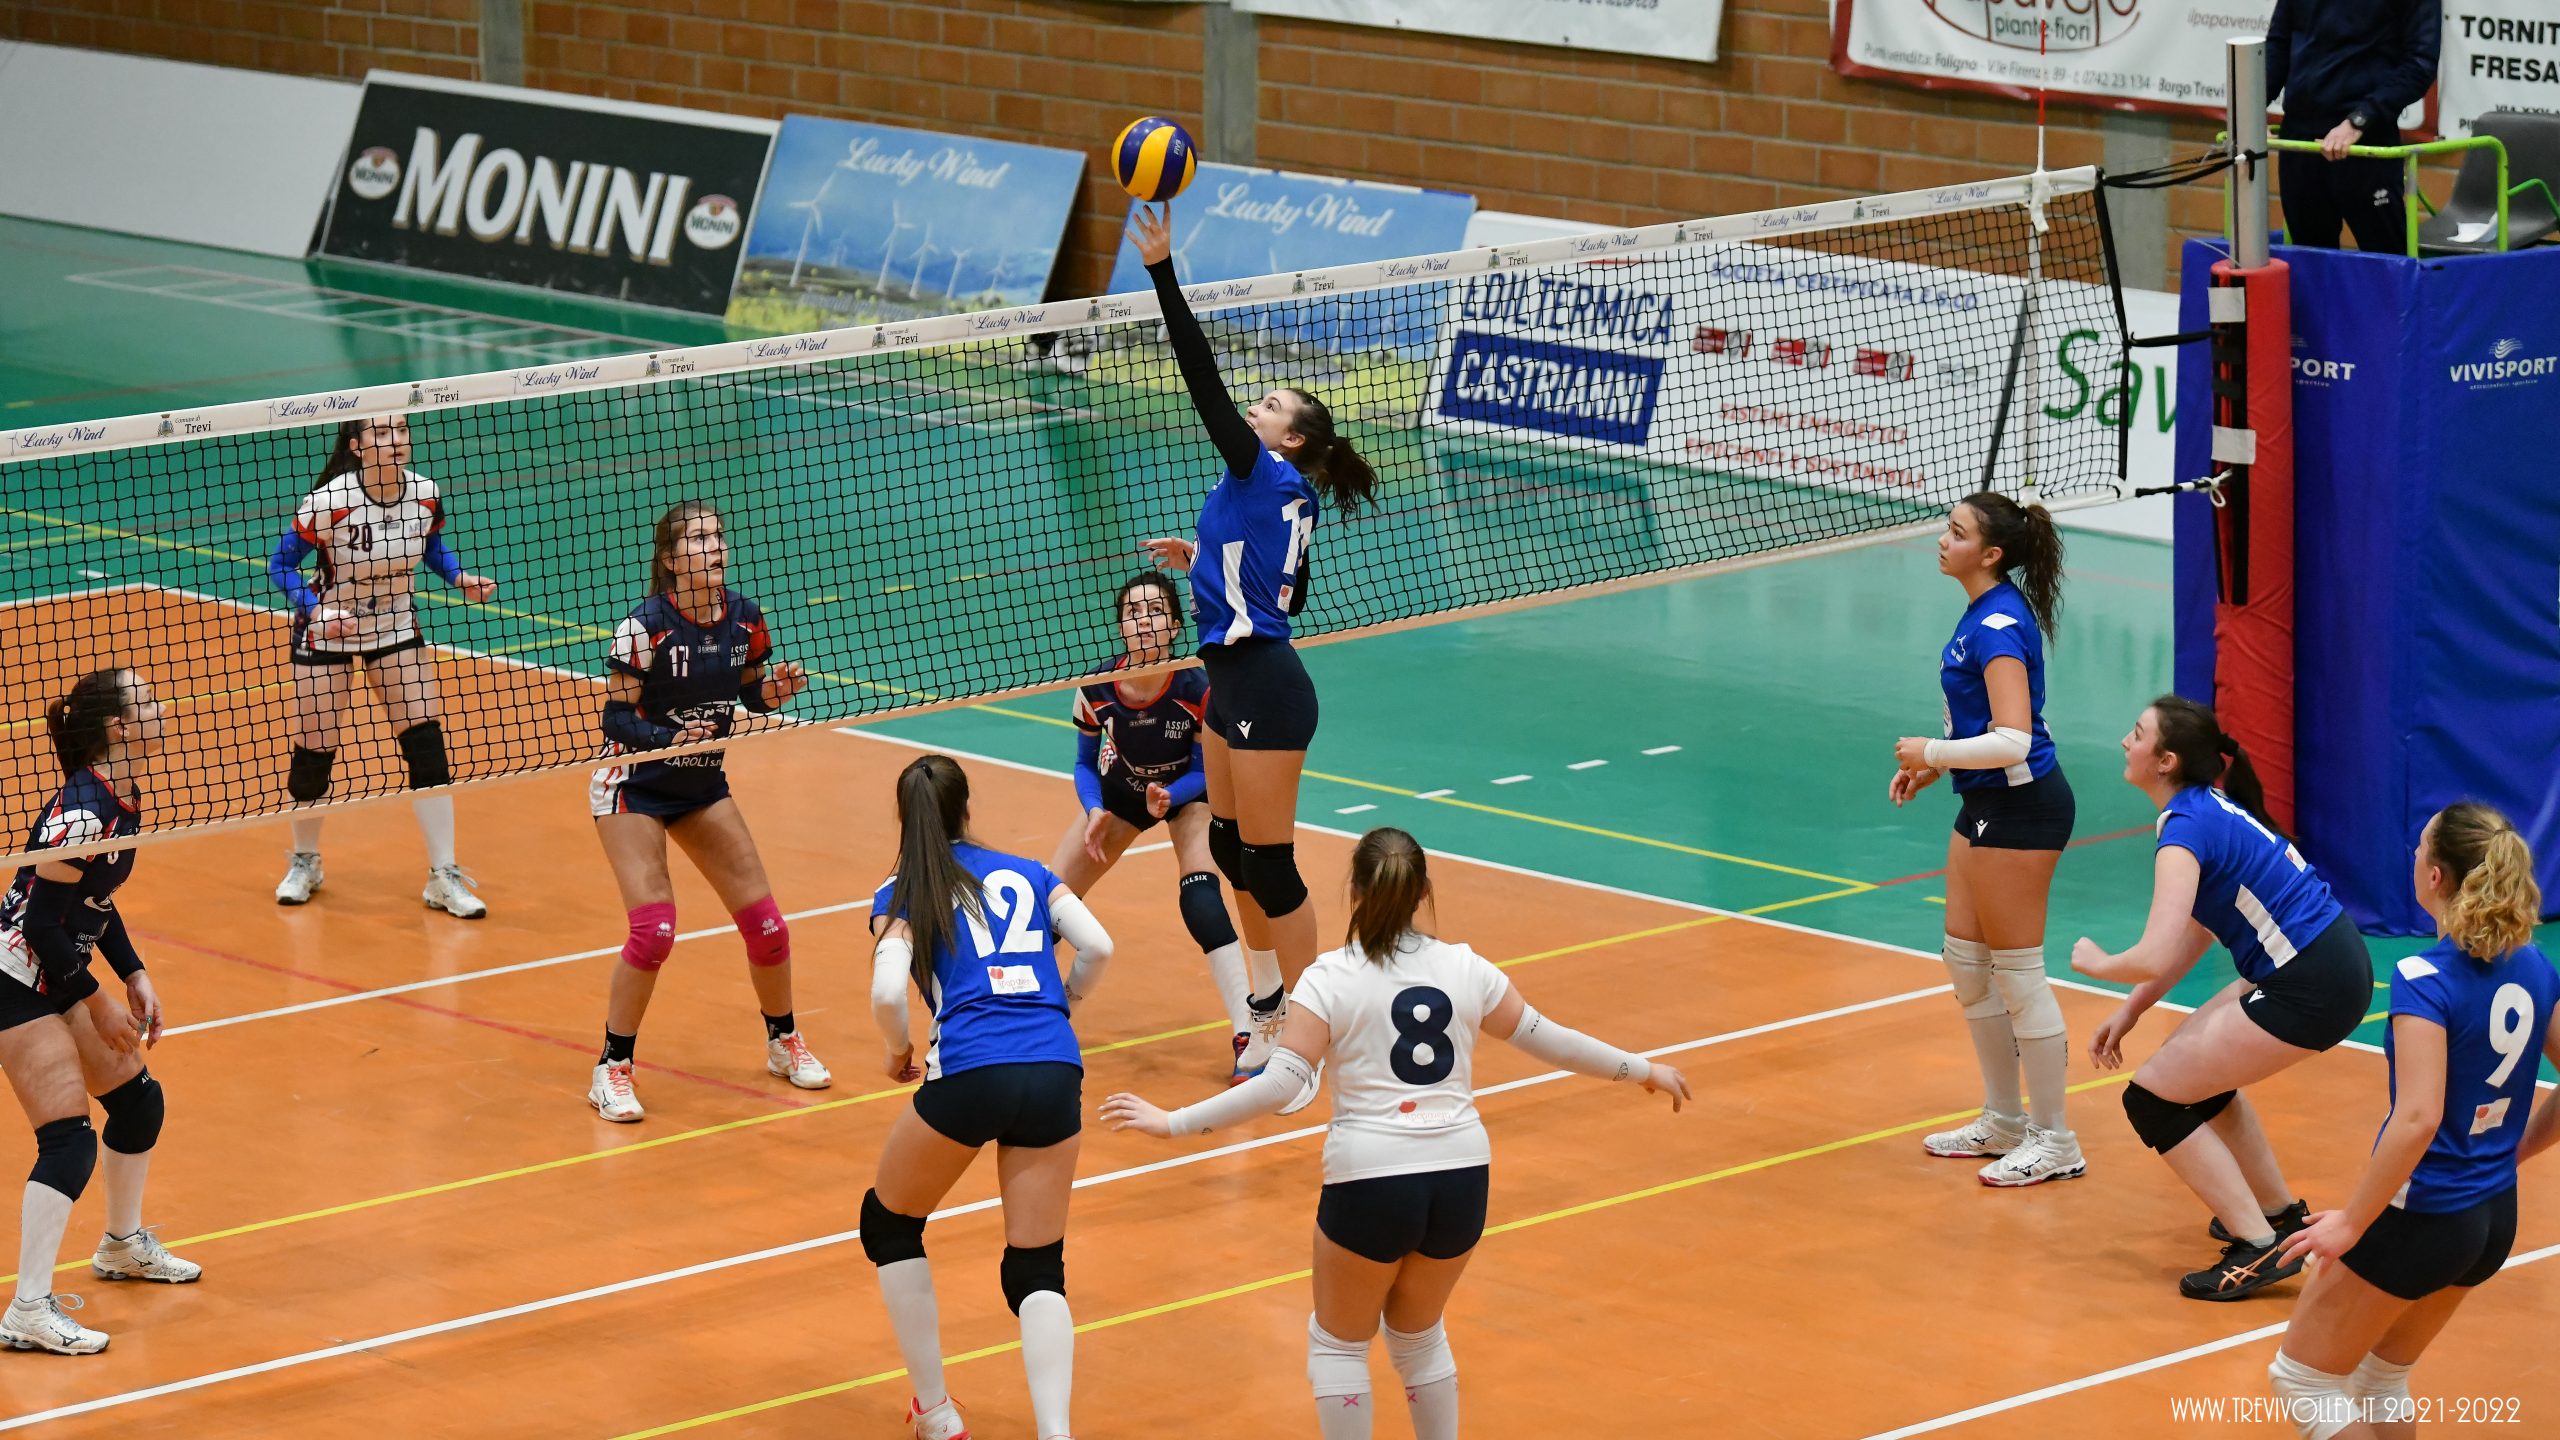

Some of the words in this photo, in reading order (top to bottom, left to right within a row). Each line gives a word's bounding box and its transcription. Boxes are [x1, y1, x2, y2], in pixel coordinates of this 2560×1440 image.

[1935, 51, 1977, 72] Foligno
[2111, 74, 2126, 87] 23
[2130, 75, 2150, 89] 134
[2158, 77, 2192, 97] Borgo
[2194, 81, 2226, 97] Trevi
[838, 134, 924, 188] Lucky
[927, 148, 1012, 191] Wind
[392, 126, 693, 266] MONINI
[1205, 181, 1301, 235] Lucky
[1306, 193, 1396, 239] Wind
[1761, 214, 1790, 228] Lucky
[1792, 209, 1819, 223] Wind
[1871, 206, 1891, 218] Trevi
[1578, 238, 1608, 252] Lucky
[1611, 234, 1639, 247] Wind
[1694, 229, 1714, 242] Trevi
[1386, 263, 1420, 278] Lucky
[1421, 258, 1450, 272] Wind
[1508, 253, 1529, 266] Trevi
[1186, 289, 1221, 304] Lucky
[1222, 283, 1253, 298] Wind
[1312, 279, 1335, 292] Trevi
[1796, 272, 1913, 302] CERTIFICATA
[975, 315, 1013, 330] Lucky
[1014, 309, 1047, 324] Wind
[1108, 305, 1132, 318] Trevi
[1463, 272, 1675, 346] EDILTERMICA
[754, 343, 791, 358] Lucky
[794, 337, 829, 352] Wind
[894, 332, 919, 346] Trevi
[522, 372, 562, 388] Lucky
[564, 366, 601, 381] Wind
[669, 361, 695, 375] Trevi
[2449, 356, 2558, 383] VIVISPORT
[277, 402, 320, 418] Lucky
[322, 395, 360, 411] Wind
[433, 391, 460, 404] Trevi
[184, 420, 213, 435] Trevi
[1719, 402, 1792, 431] SISTEMI
[1798, 413, 1909, 445] ENERGETICI
[20, 433, 65, 449] Lucky
[67, 426, 107, 442] Wind
[1684, 436, 1785, 468] EFFICIENTI
[348, 523, 373, 553] 20
[668, 645, 690, 678] 17
[1181, 873, 1208, 888] ALLSIX
[951, 868, 1044, 959] 12
[1390, 985, 1455, 1086] 8
[2485, 982, 2535, 1089] 9
